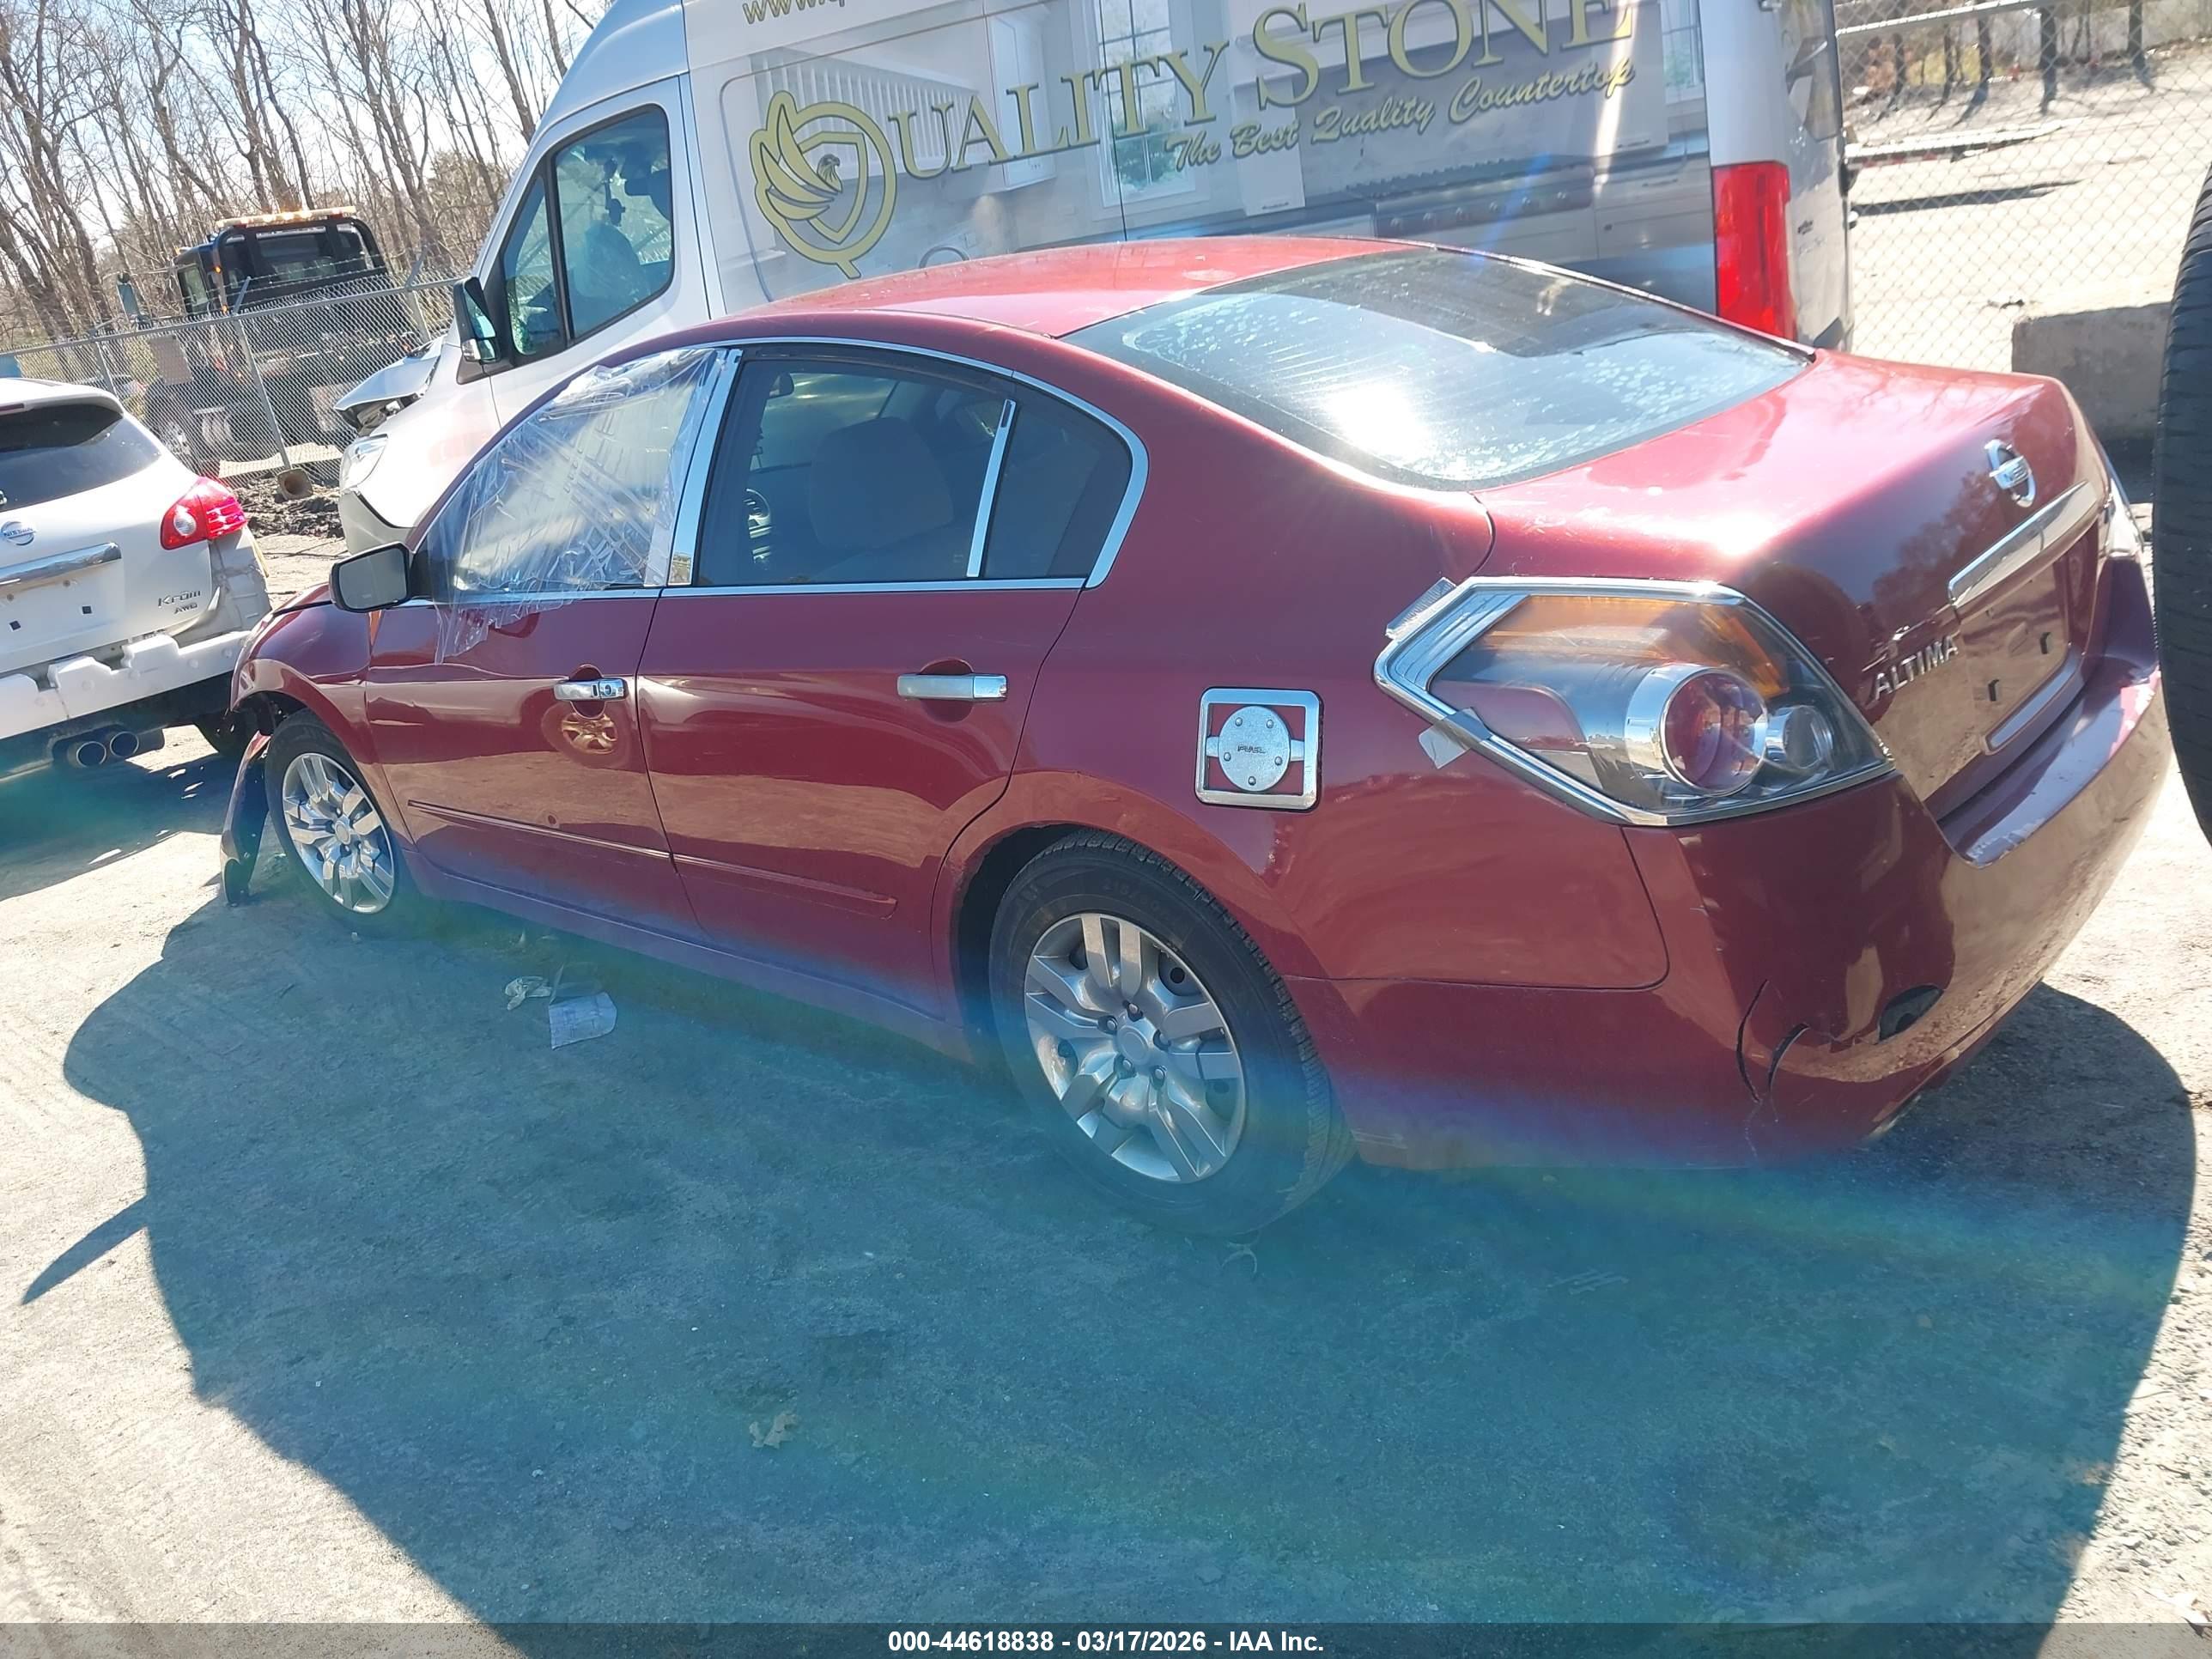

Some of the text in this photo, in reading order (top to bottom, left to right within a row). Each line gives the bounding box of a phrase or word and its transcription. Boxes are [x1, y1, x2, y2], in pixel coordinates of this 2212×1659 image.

[1252, 0, 1634, 110] STONE
[1165, 131, 1221, 172] The
[1230, 118, 1301, 159] Best
[1312, 94, 1436, 143] Quality
[1874, 635, 1959, 700] ALTIMA
